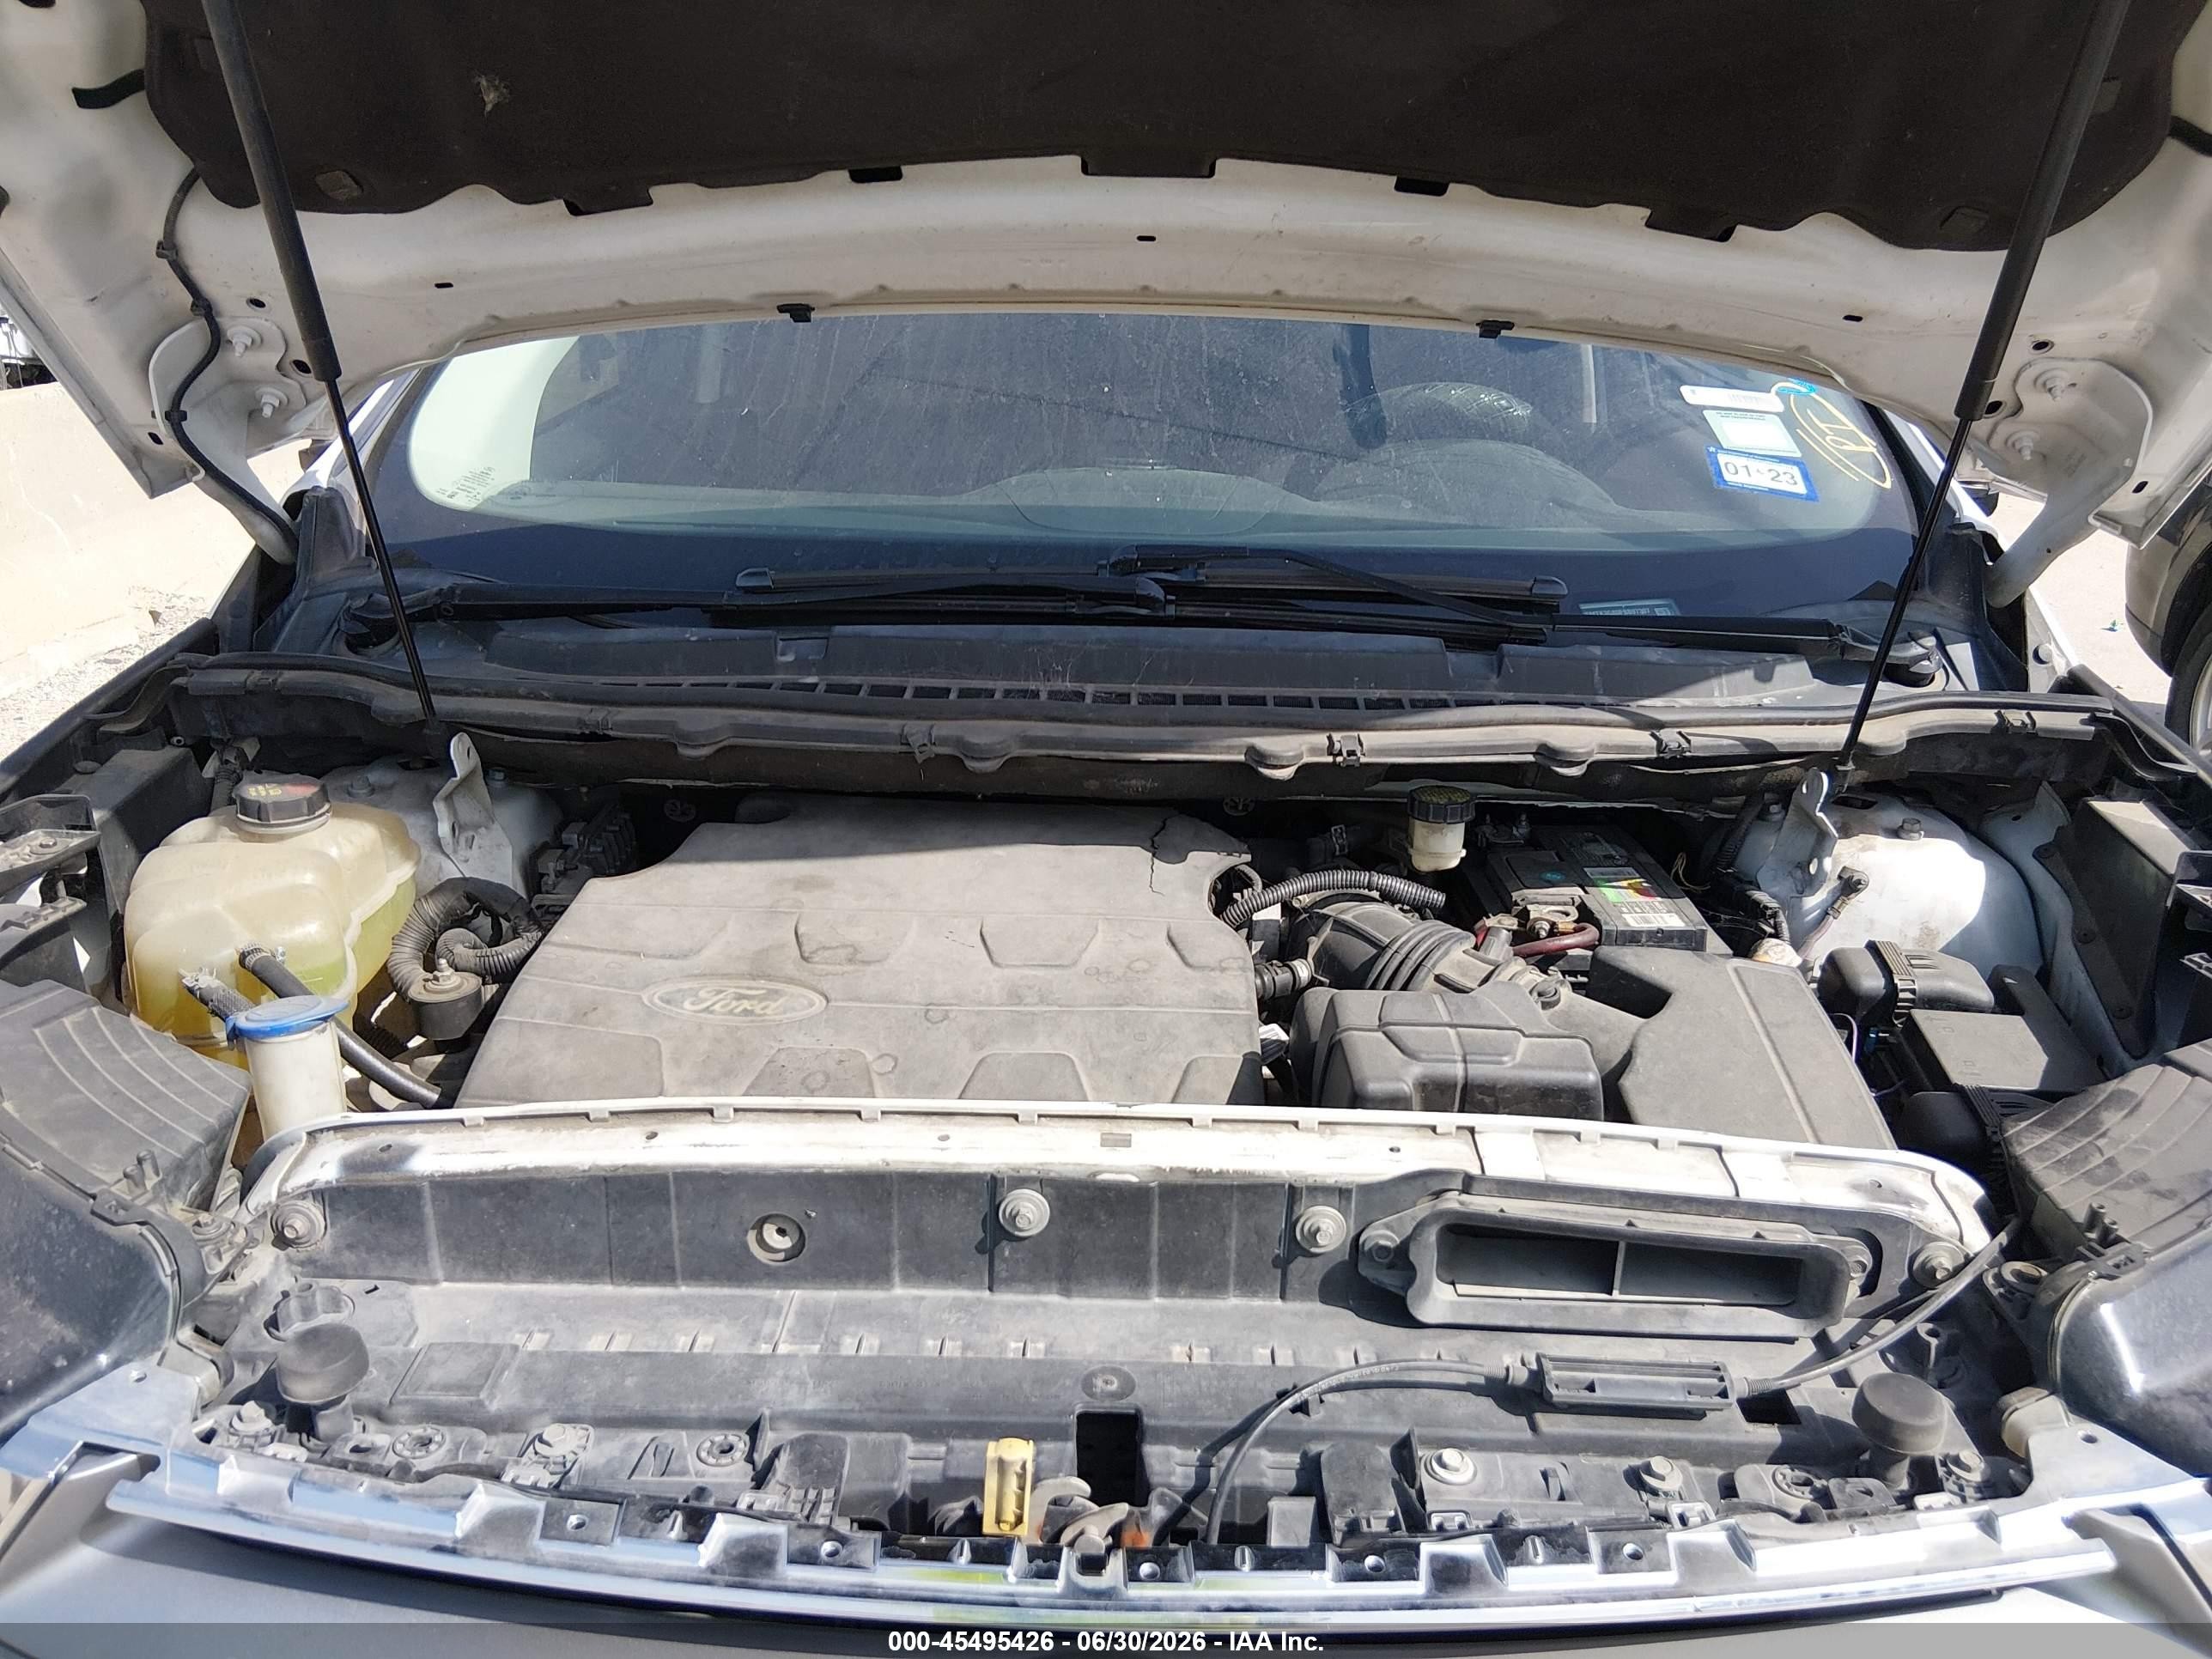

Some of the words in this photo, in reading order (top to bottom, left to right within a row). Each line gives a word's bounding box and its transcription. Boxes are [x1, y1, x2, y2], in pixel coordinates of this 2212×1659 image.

[1723, 461, 1752, 478] 01
[1767, 468, 1798, 486] 23
[683, 988, 790, 1017] Ford
